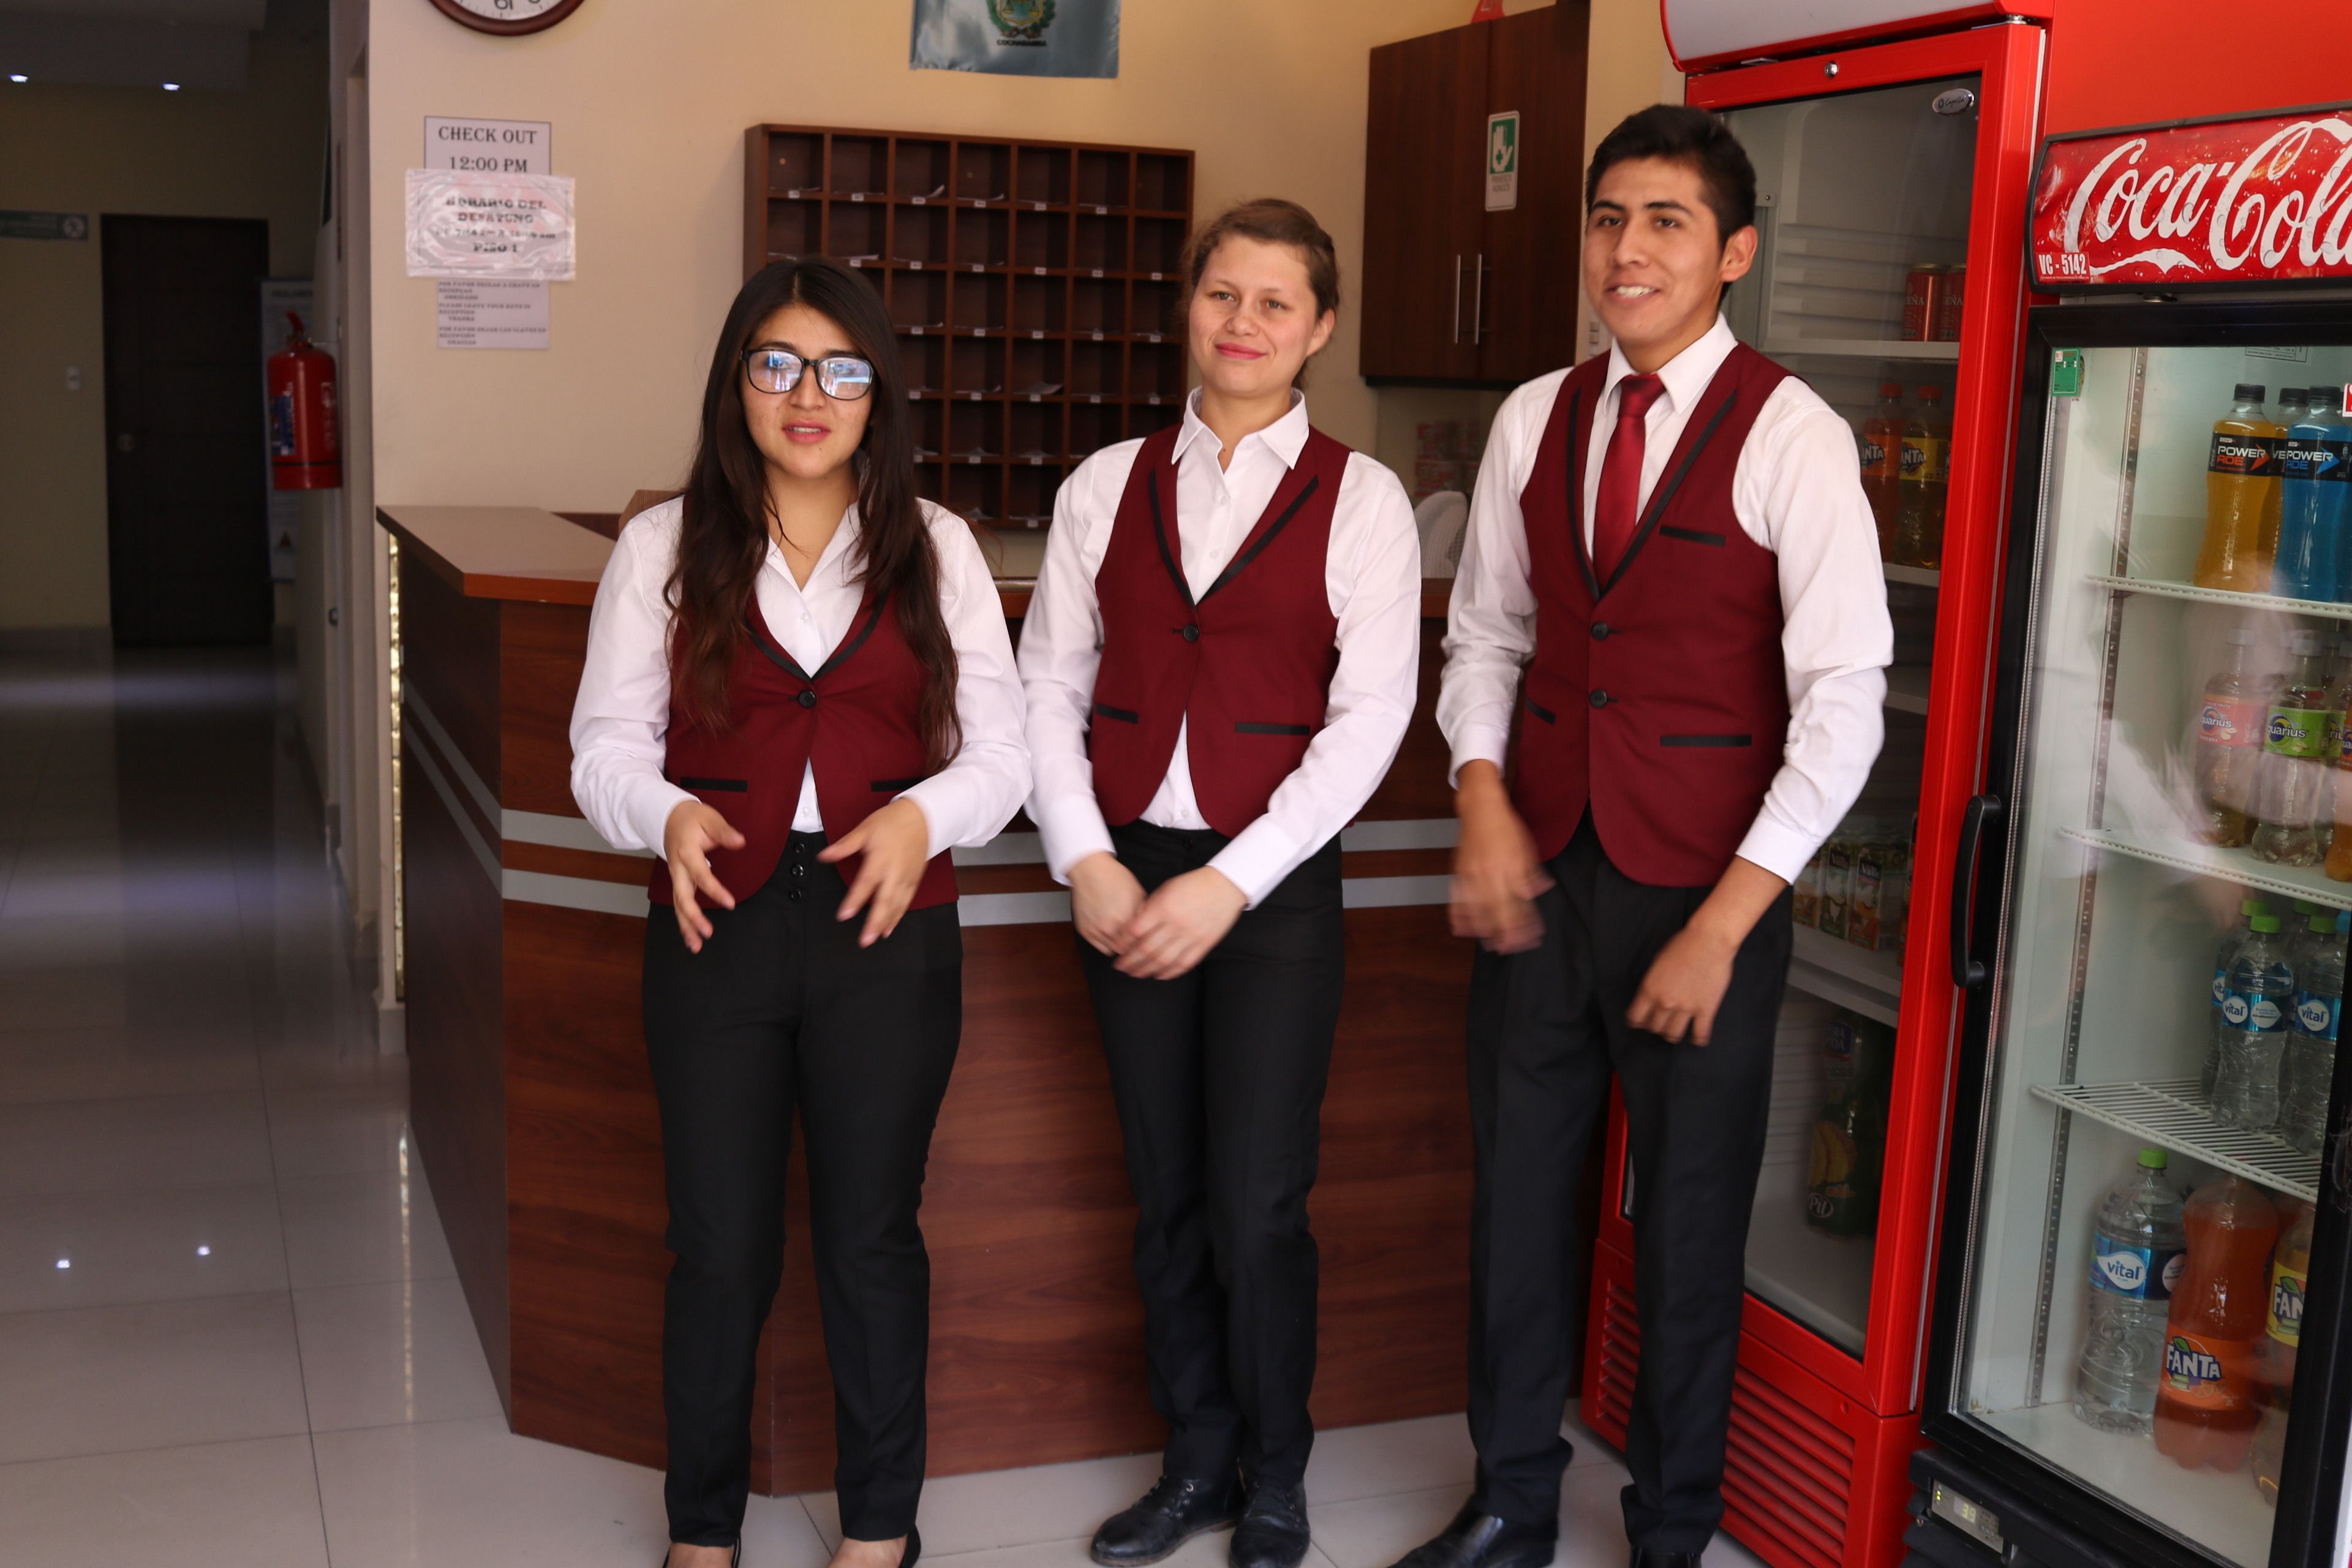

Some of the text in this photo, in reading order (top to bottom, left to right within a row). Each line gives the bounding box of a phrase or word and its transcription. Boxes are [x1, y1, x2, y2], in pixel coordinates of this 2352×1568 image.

[439, 126, 538, 145] CHECK OUT
[450, 156, 529, 173] 12:00 PM
[2038, 254, 2054, 275] VC
[2061, 253, 2087, 275] 5142
[2216, 455, 2244, 466] ADE
[2217, 445, 2266, 459] POWER
[2286, 450, 2334, 462] POWER
[2200, 715, 2233, 728] quarius
[2266, 725, 2307, 738] quarius
[2225, 1002, 2244, 1017] vital
[2301, 1006, 2324, 1023] vital
[2107, 1261, 2140, 1281] vital
[2273, 1286, 2305, 1319] FAN
[2166, 1344, 2221, 1379] FANTA
